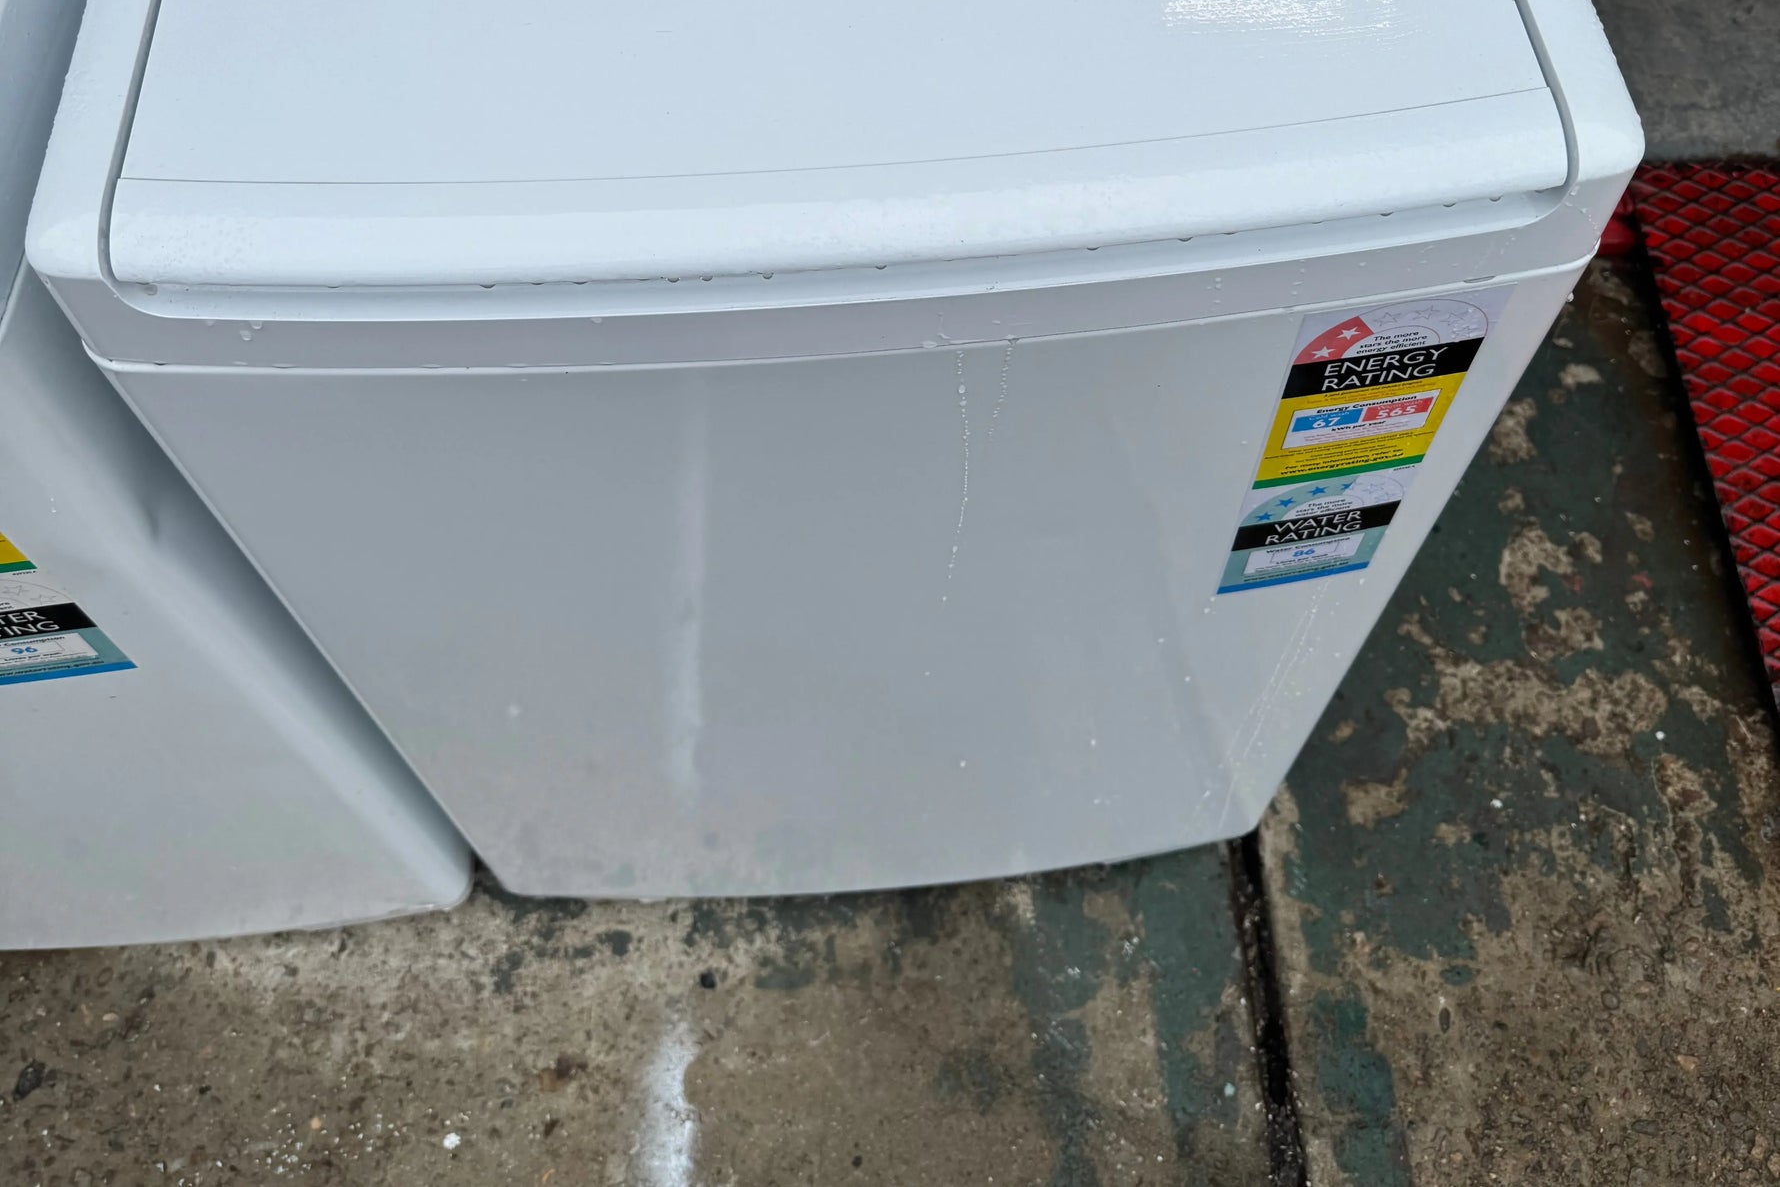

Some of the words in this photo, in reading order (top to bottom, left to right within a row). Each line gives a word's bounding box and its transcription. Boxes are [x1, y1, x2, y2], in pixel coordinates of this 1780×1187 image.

[1324, 347, 1448, 376] ENERGY
[1322, 364, 1436, 391] RATING
[1317, 405, 1350, 413] Energy
[1352, 396, 1417, 408] Consumption
[1376, 405, 1417, 419] 565
[1313, 417, 1340, 428] 67
[1275, 511, 1362, 532] WATER
[1265, 521, 1362, 545] RATING
